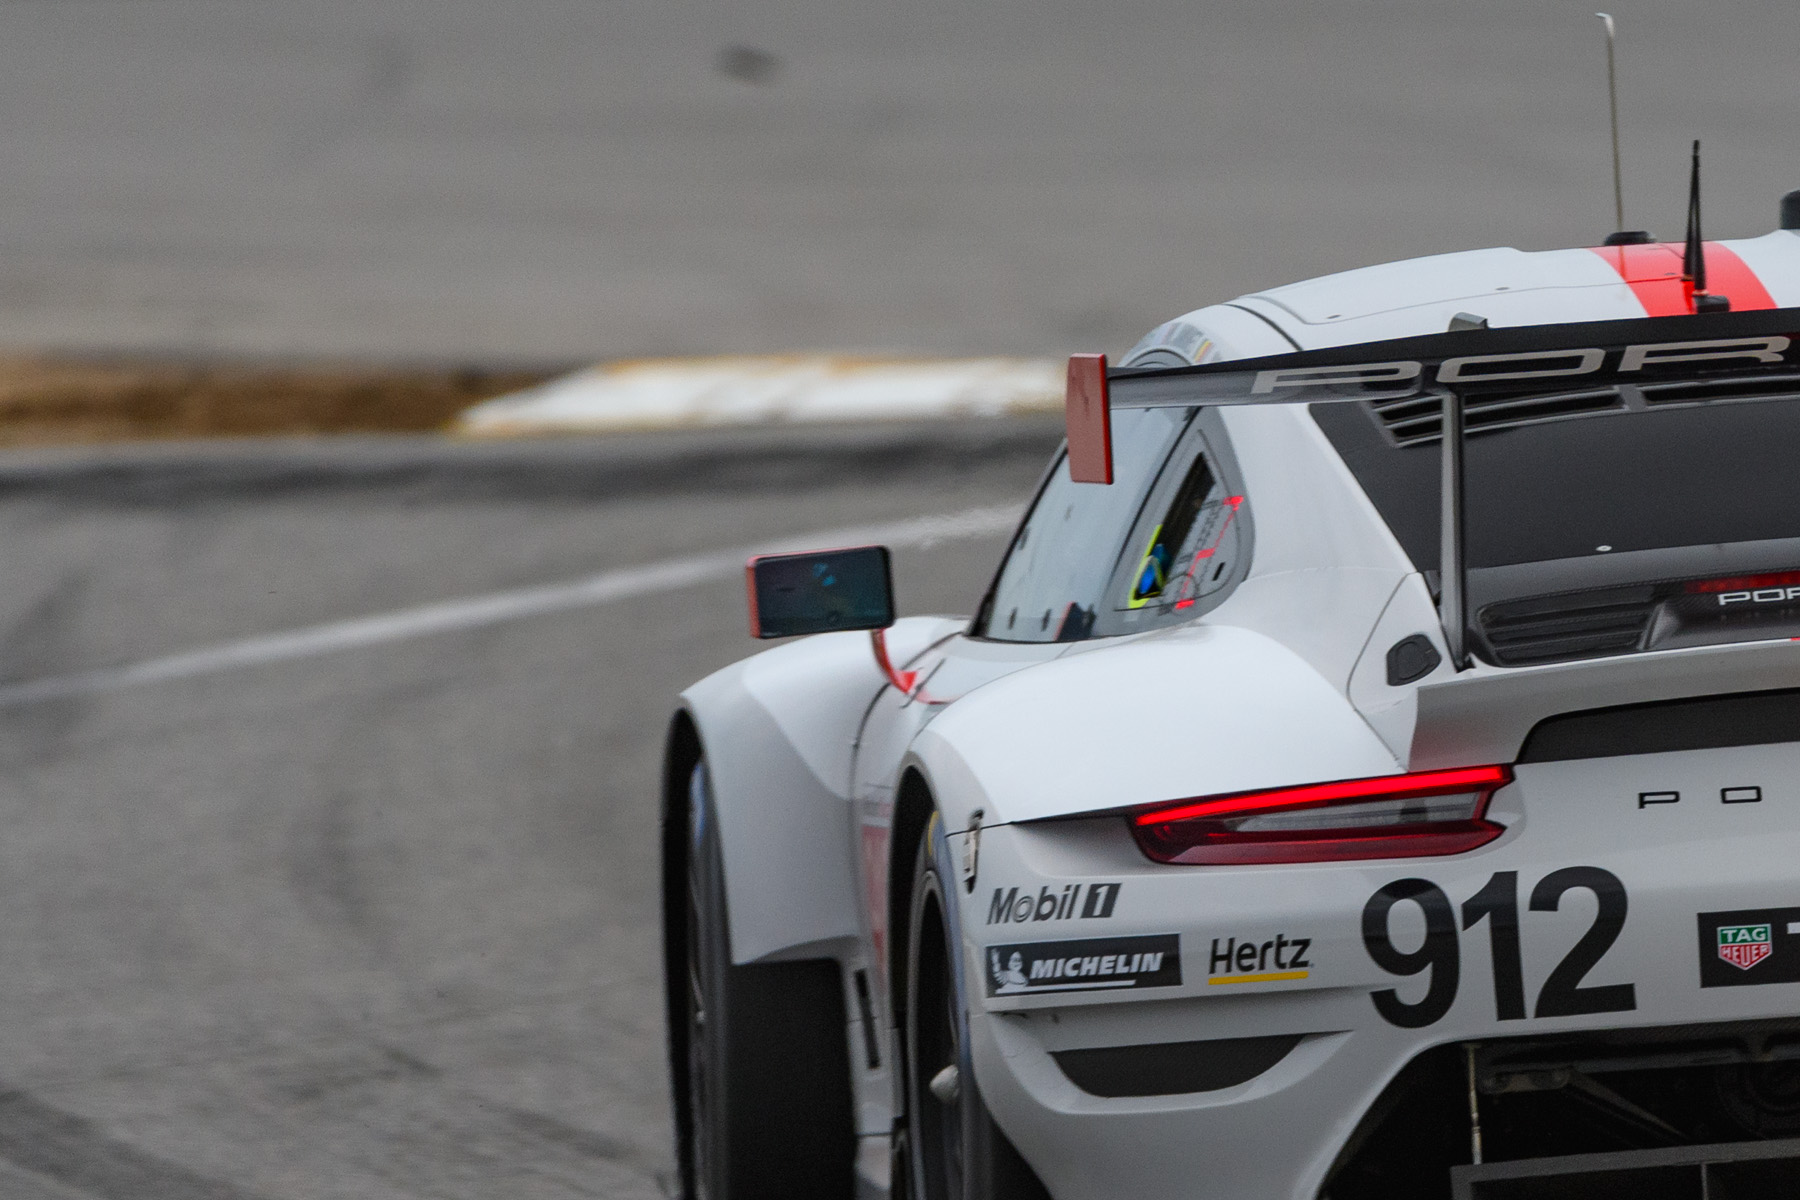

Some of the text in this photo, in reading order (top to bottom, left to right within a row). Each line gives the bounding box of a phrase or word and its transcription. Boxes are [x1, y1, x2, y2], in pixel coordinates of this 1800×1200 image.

[986, 884, 1115, 925] Mobil 1
[1360, 866, 1638, 1029] 912
[1722, 927, 1767, 943] TAG
[1029, 952, 1165, 980] MICHELIN
[1208, 933, 1312, 975] Hertz
[1721, 944, 1768, 966] HEUER
